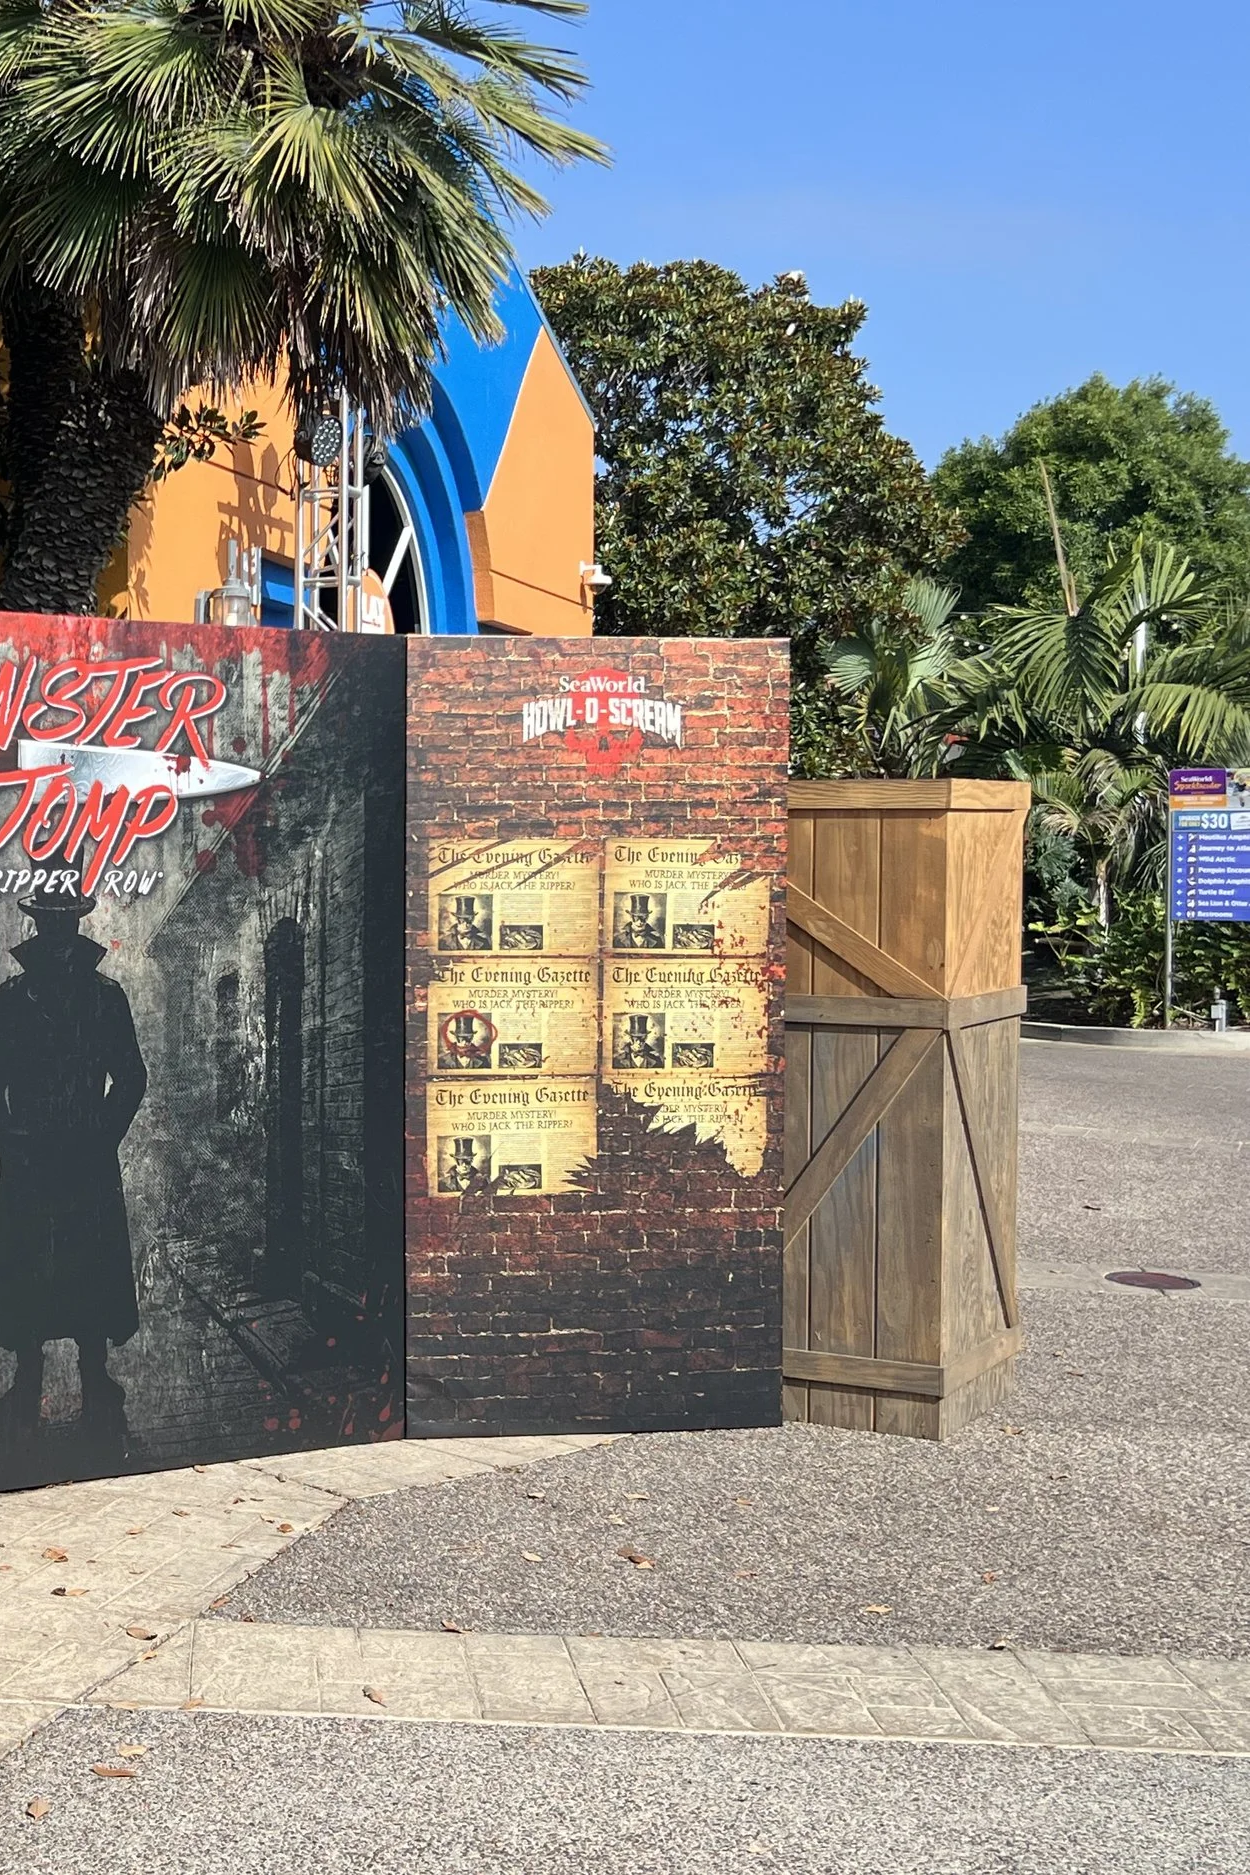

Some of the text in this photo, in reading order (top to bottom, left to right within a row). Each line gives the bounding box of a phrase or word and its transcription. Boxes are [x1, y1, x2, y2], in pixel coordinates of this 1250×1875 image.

[559, 675, 648, 694] SeaWorld
[522, 697, 683, 751] HOWL-O-SCREAM
[1201, 813, 1229, 829] $30
[438, 848, 467, 864] The
[614, 845, 642, 864] The
[645, 870, 684, 879] MURDER
[488, 882, 512, 892] JACK
[540, 882, 575, 891] RIPPER?
[629, 880, 652, 888] WHO
[654, 880, 663, 888] IS
[665, 881, 686, 891] JACK
[691, 881, 709, 890] THE
[437, 966, 591, 986] The Evening Gazette
[612, 966, 639, 985] The
[645, 966, 705, 986] Evening
[468, 989, 558, 998] MURDER MYSTERY!
[643, 990, 682, 998] MURDER
[452, 1000, 574, 1010] WHO IS JACK THE RIPPER?
[627, 1000, 650, 1009] WHO
[652, 1000, 661, 1009] IS
[663, 1000, 685, 1010] JACK
[644, 1081, 702, 1100] Evening
[436, 1086, 589, 1108] The Evening Gazette
[467, 1110, 557, 1120] MURDER MYSTERY!
[687, 1115, 707, 1123] THE
[452, 1120, 573, 1132] WHO IS JACK THE RIPPER?
